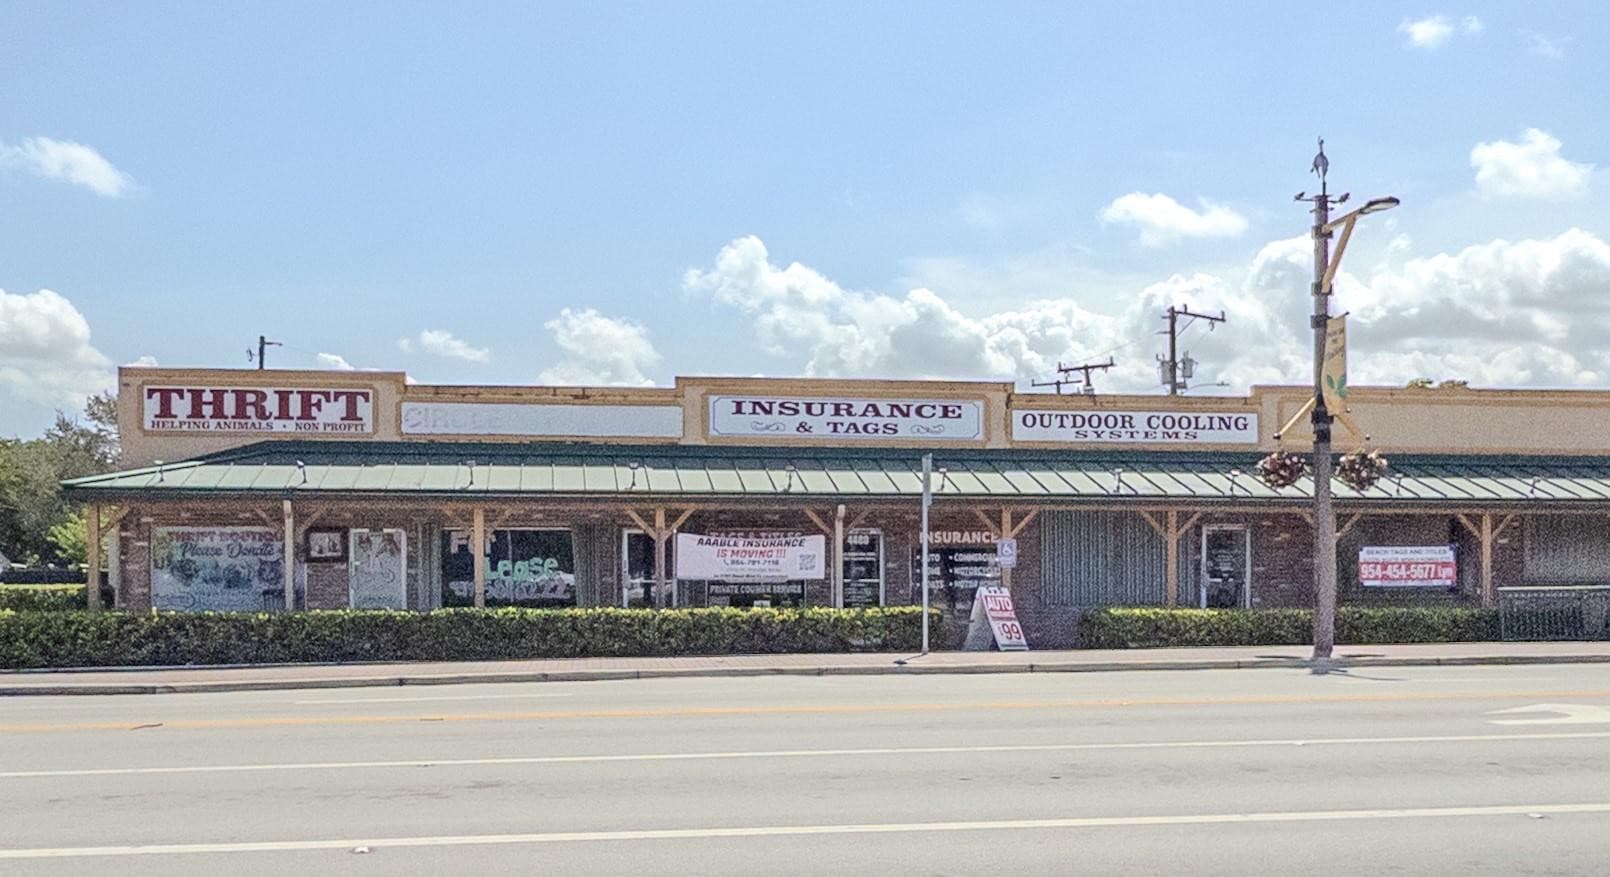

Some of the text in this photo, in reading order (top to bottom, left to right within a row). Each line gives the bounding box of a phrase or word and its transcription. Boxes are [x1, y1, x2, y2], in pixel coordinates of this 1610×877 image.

[147, 388, 370, 421] THRIFT
[731, 400, 962, 419] INSURANCE
[151, 420, 367, 432] HELPING ANIMALS NON PROFIT
[796, 421, 899, 435] & TAGS
[1021, 413, 1249, 431] OUTDOOR COOLING
[1074, 430, 1199, 440] SYSTEMS
[742, 537, 806, 547] INSURANCE
[180, 541, 275, 559] Please Donate
[716, 548, 728, 559] IS
[730, 548, 774, 559] MOVING
[484, 557, 559, 581] Lease
[985, 596, 1014, 611] AUTO
